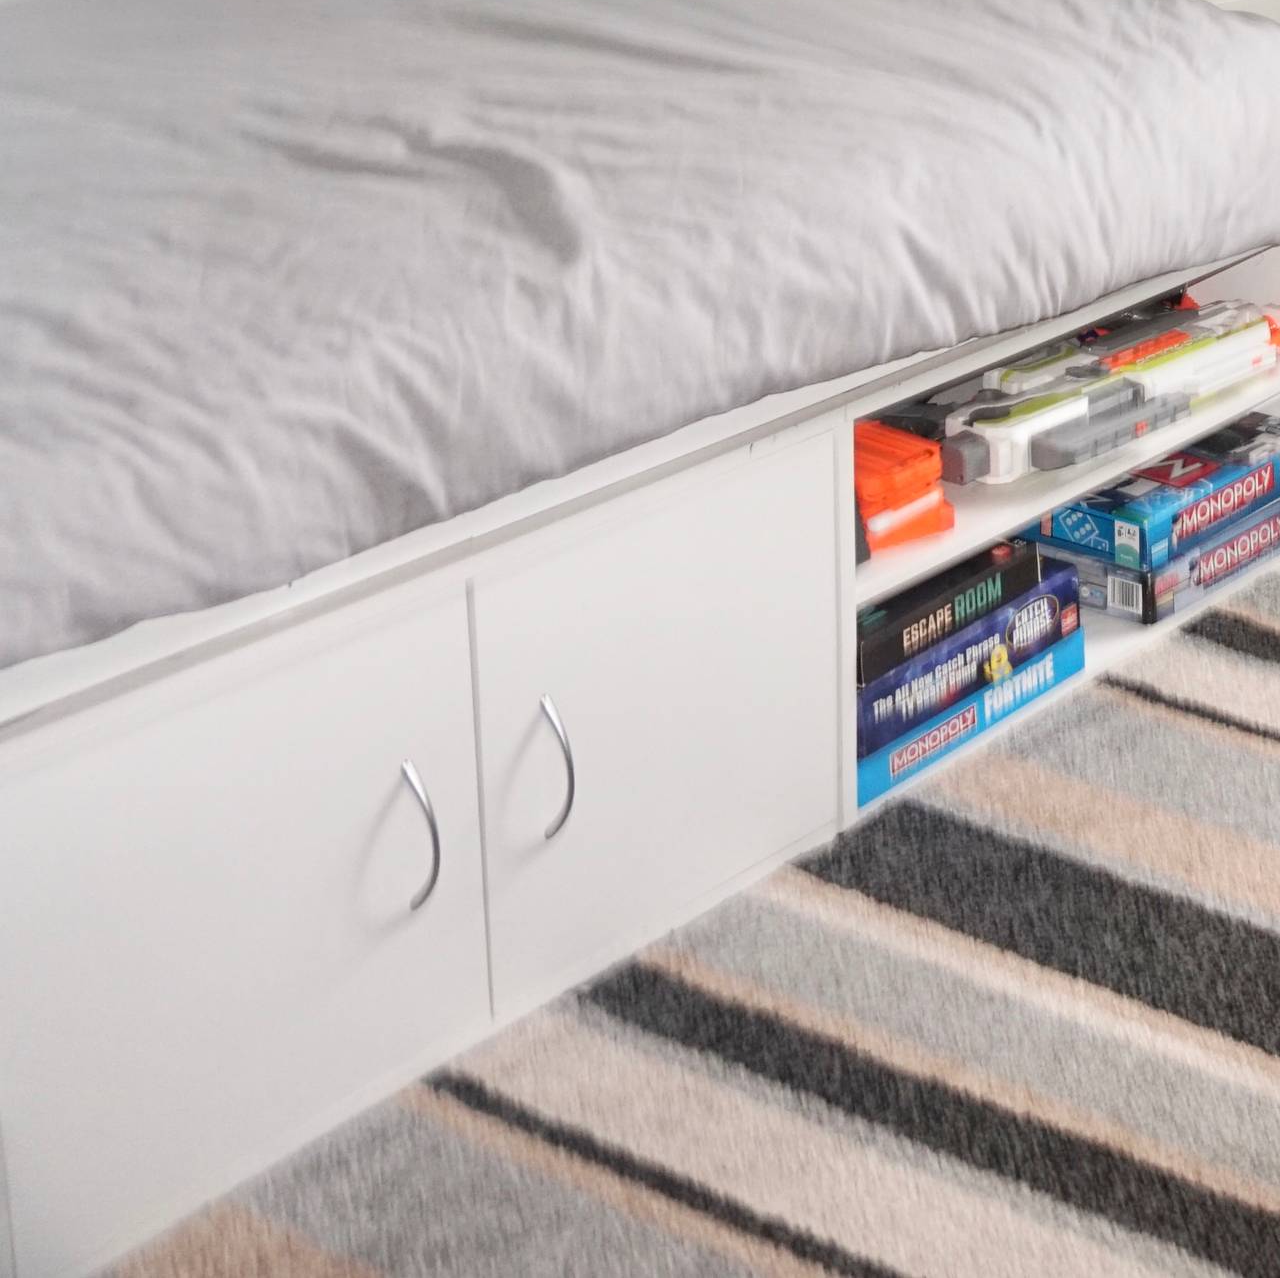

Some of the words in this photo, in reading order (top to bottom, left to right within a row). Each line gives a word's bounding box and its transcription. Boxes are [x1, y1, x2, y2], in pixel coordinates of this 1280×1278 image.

[1181, 465, 1273, 535] MONOPOLY
[903, 603, 953, 652] ESCAPE
[953, 572, 1003, 623] ROOM
[872, 695, 894, 723] The
[892, 706, 976, 774] MONOPOLY
[983, 652, 1055, 722] FORTNITE
